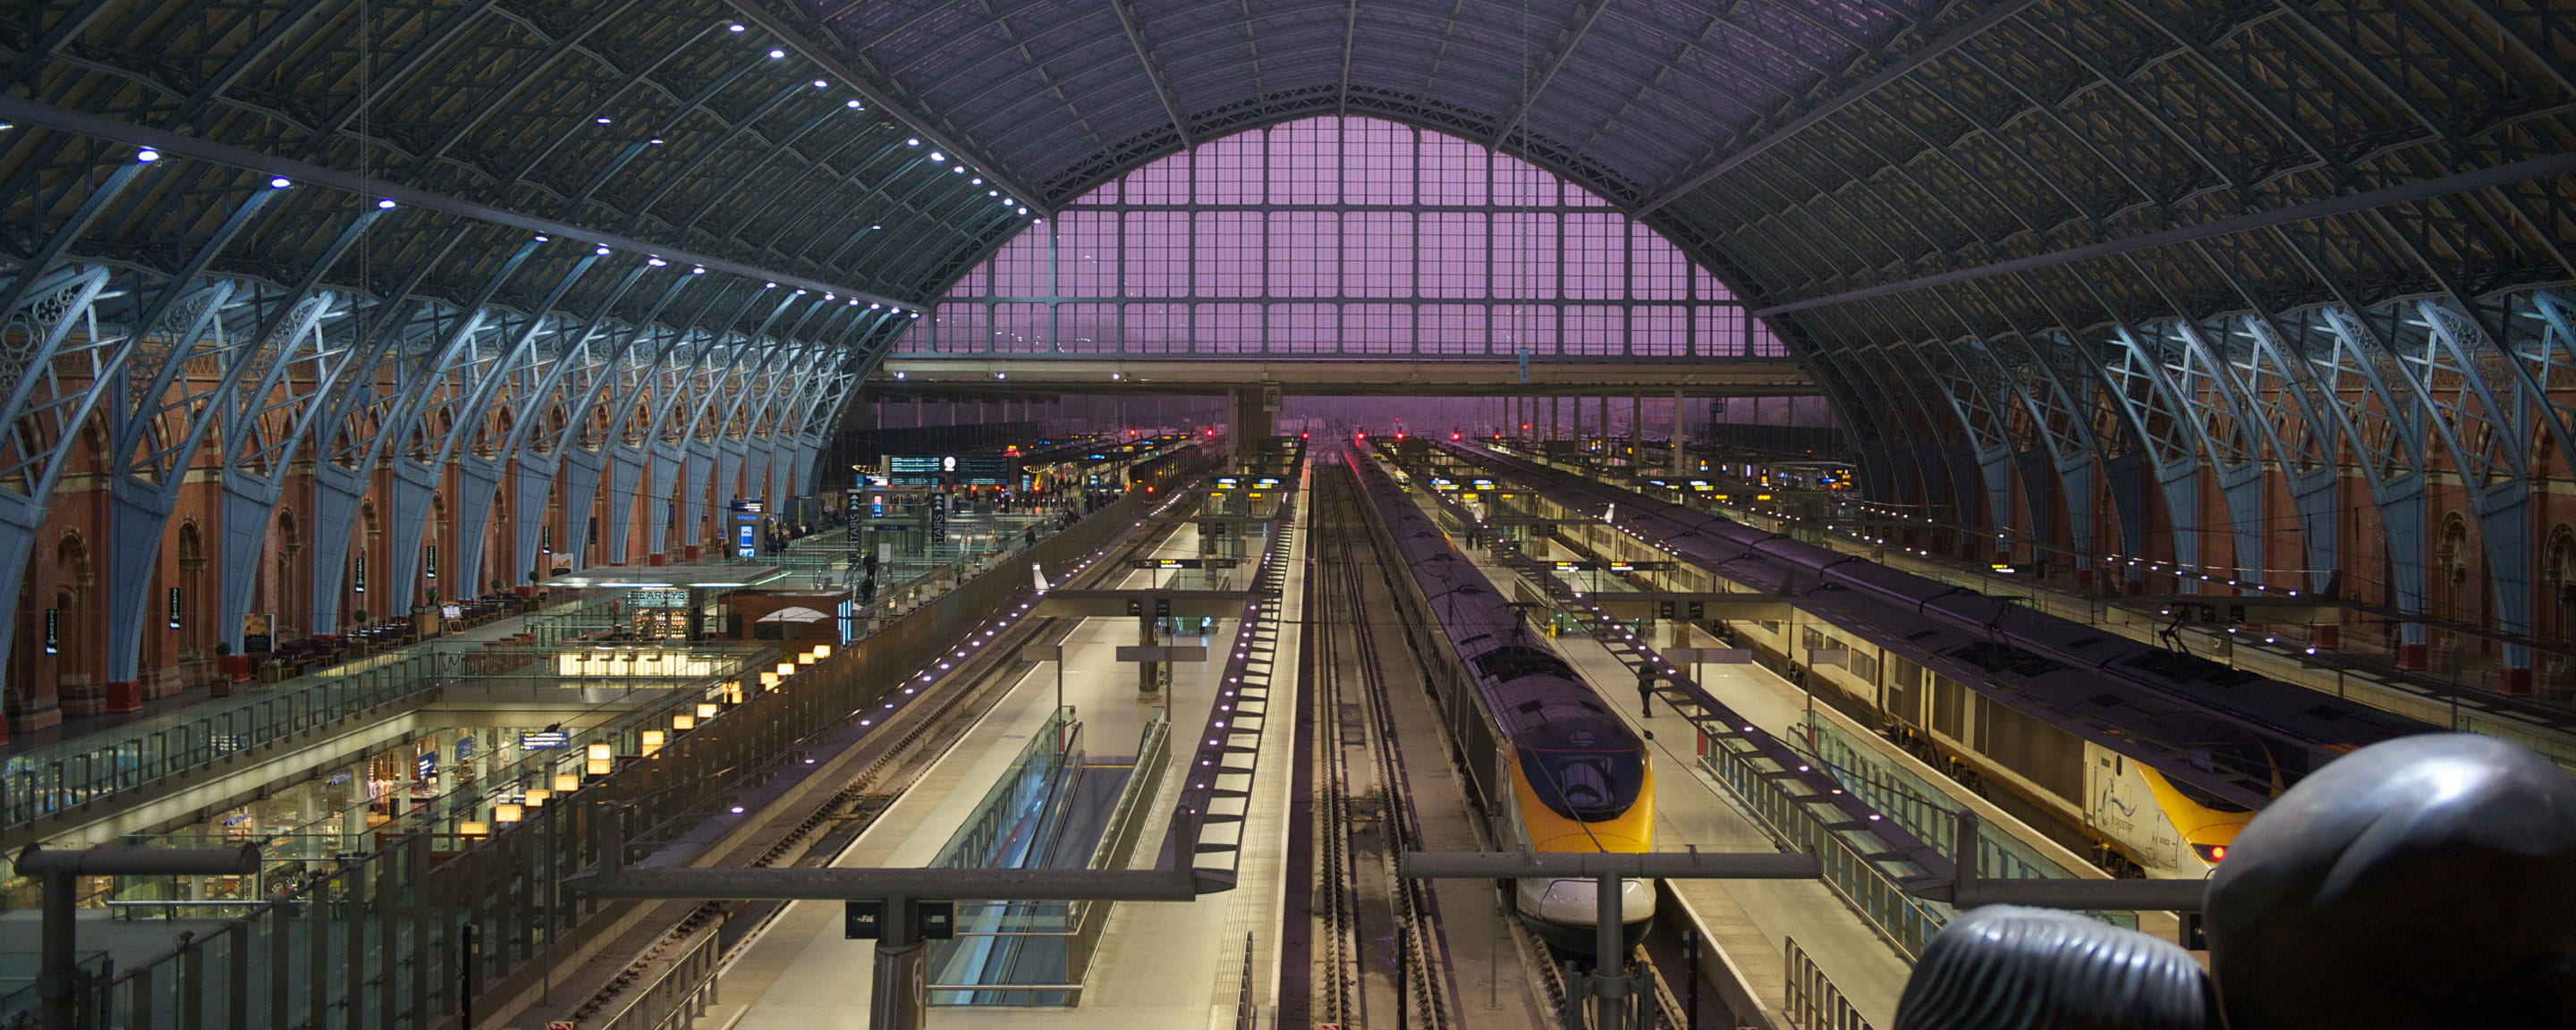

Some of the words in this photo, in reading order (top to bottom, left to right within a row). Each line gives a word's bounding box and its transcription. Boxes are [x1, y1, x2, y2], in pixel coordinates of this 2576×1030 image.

[631, 591, 686, 600] SEARCYS
[1153, 621, 1159, 642] 6
[912, 958, 922, 1007] 6
